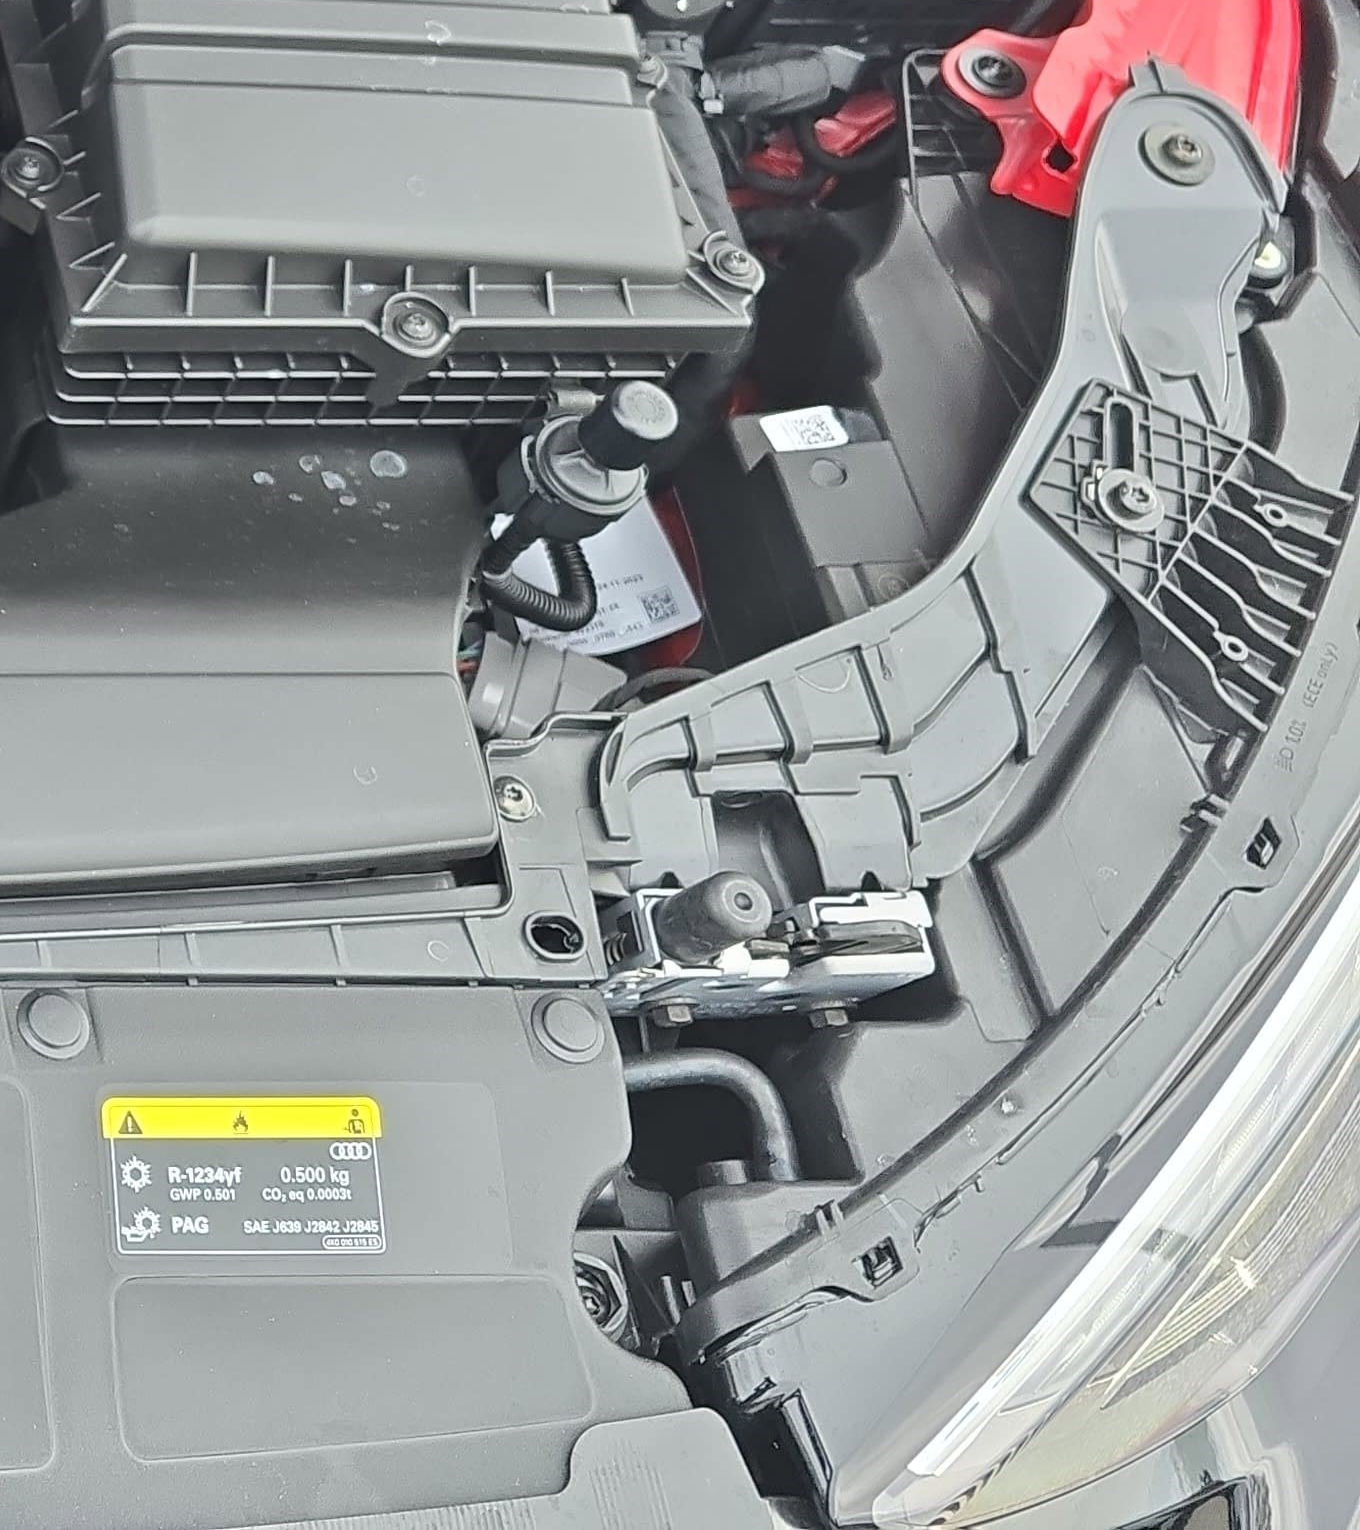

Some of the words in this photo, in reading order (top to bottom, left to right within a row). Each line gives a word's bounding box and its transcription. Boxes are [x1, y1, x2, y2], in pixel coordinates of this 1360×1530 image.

[167, 1166, 242, 1187] R-1234yf
[280, 1166, 326, 1184] 0.500
[329, 1166, 350, 1186] kg
[169, 1188, 202, 1202] GWP
[203, 1188, 236, 1201] 0.501
[289, 1189, 305, 1203] eq
[306, 1187, 352, 1201] 0.0003t
[171, 1216, 210, 1234] PAG
[243, 1220, 270, 1234] SAE
[272, 1220, 302, 1234] J639
[304, 1220, 341, 1233] J2842
[342, 1219, 379, 1233] J2845
